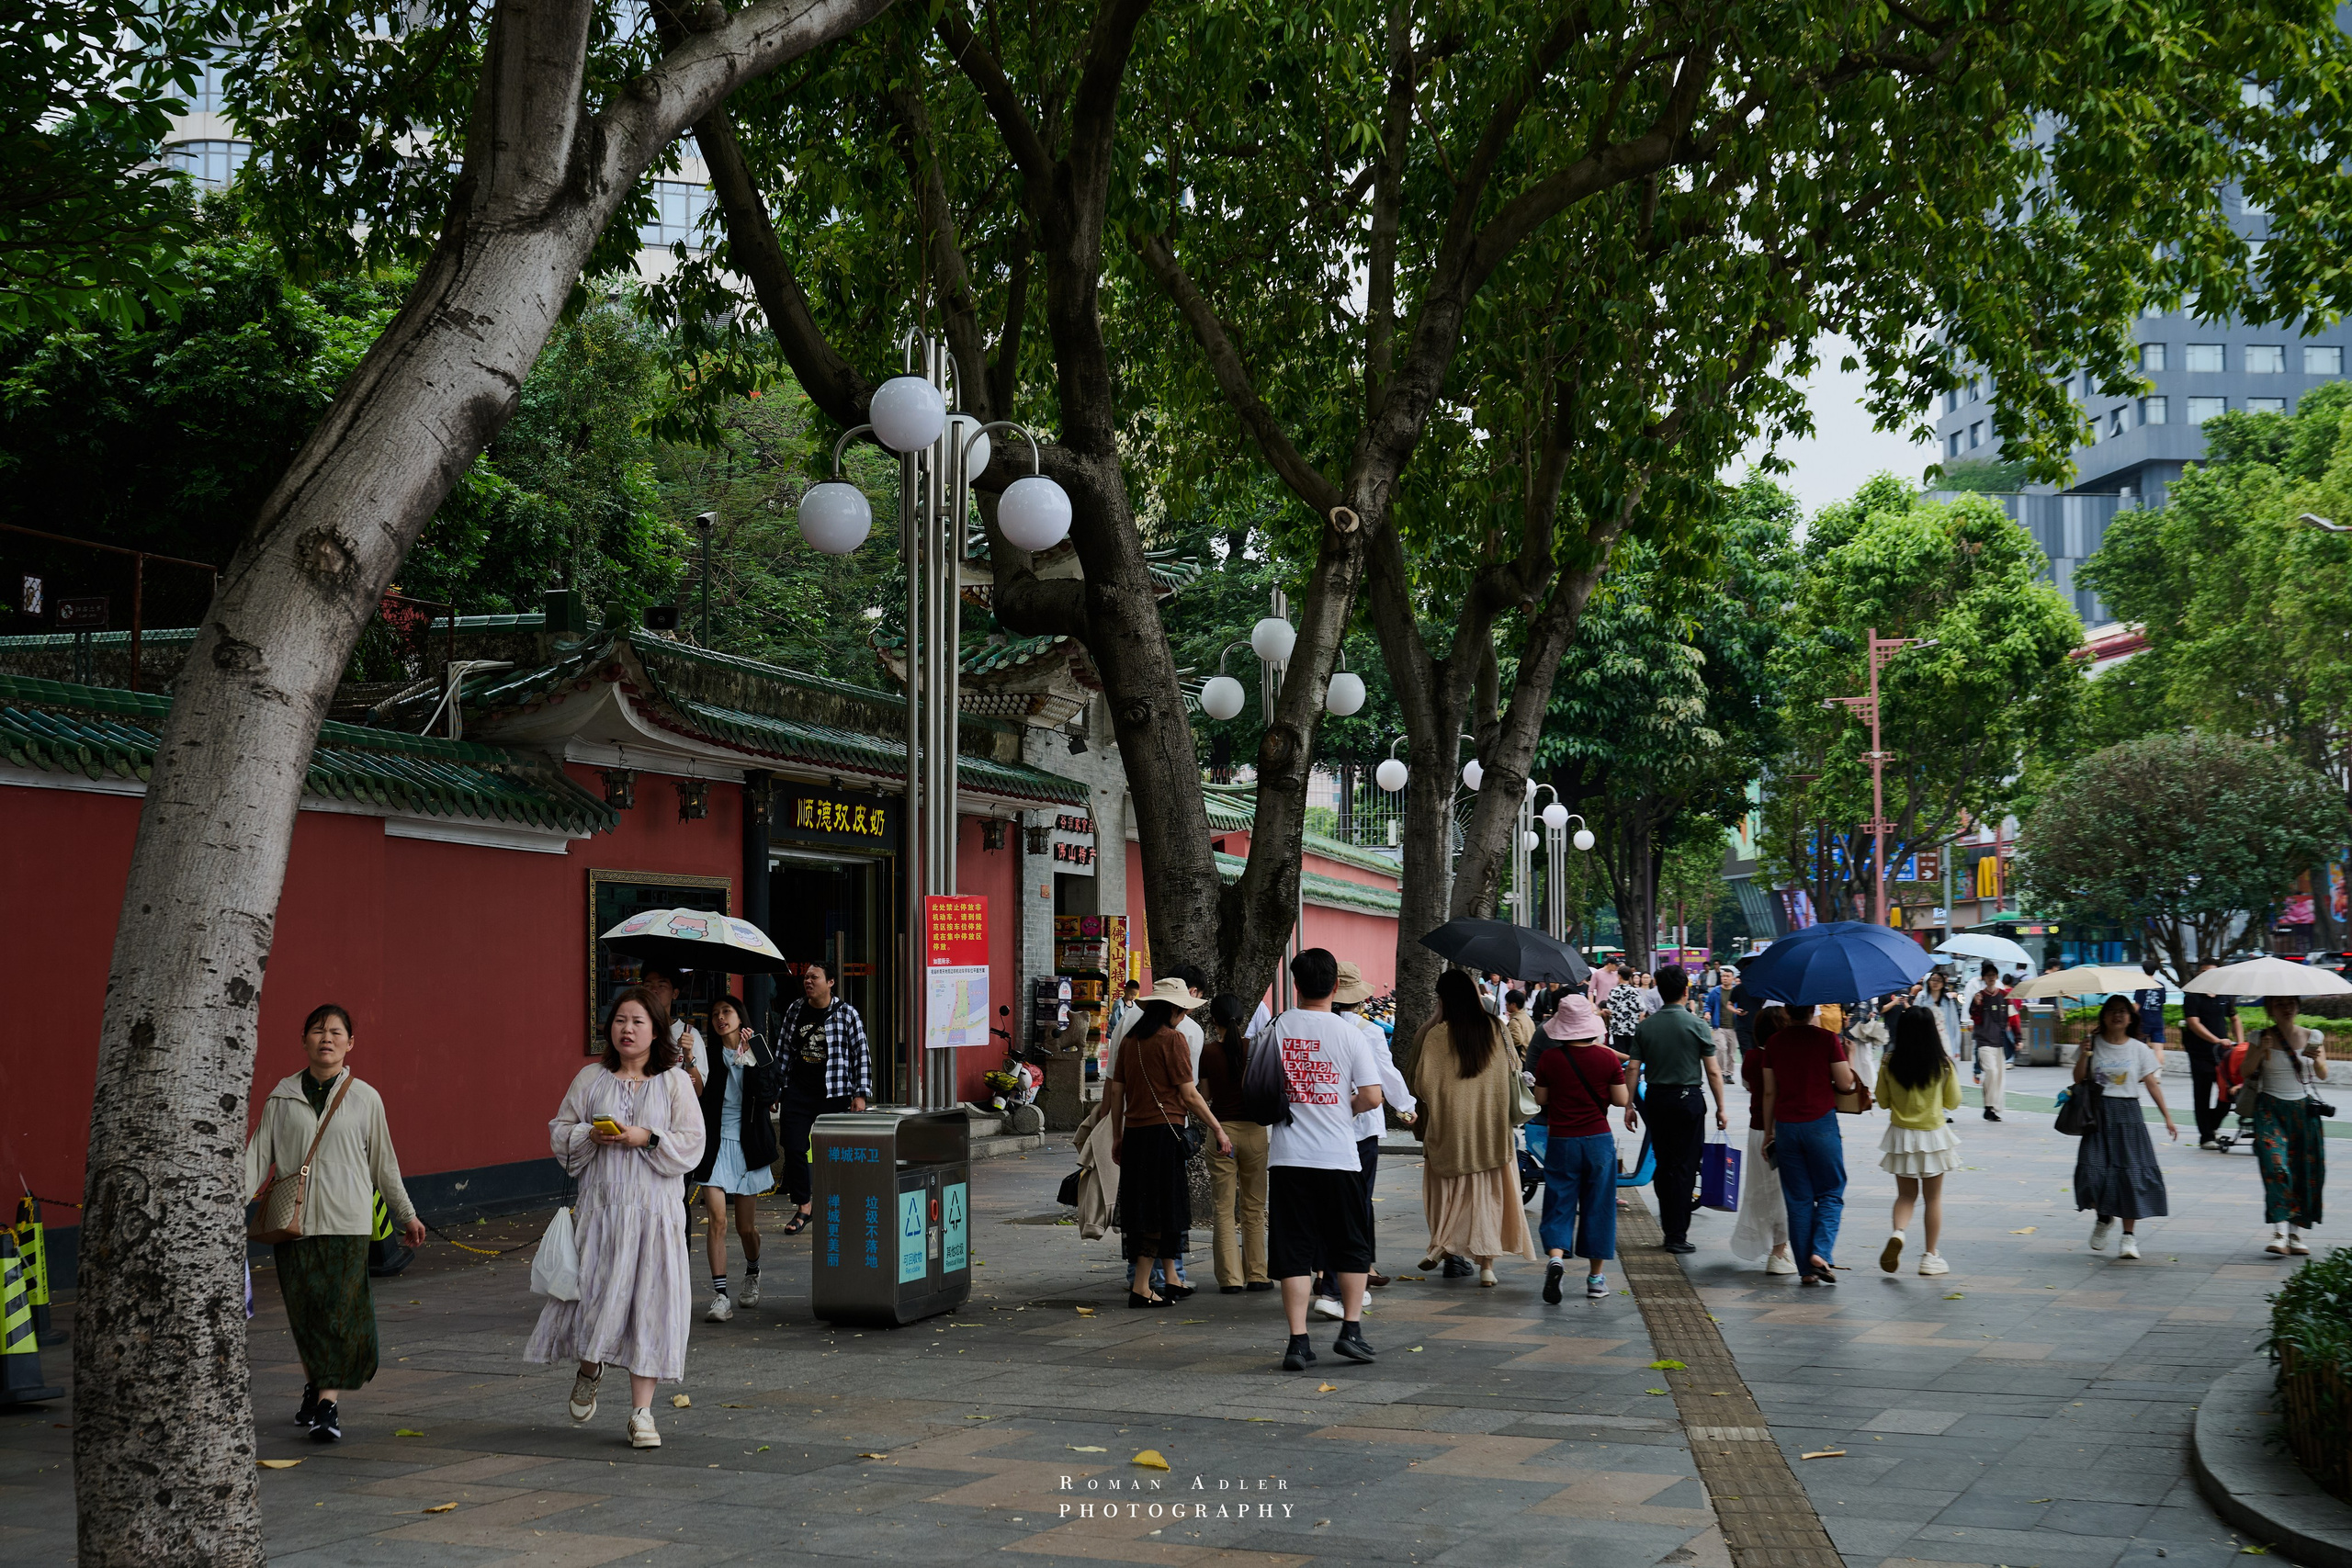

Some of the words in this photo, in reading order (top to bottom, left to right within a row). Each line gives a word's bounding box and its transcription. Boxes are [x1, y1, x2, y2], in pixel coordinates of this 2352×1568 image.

[797, 798, 885, 837] 顺德双皮奶
[1057, 842, 1097, 864] 佛山特产
[932, 903, 982, 911] 此处禁止停放非
[933, 922, 982, 931] 范区按车位停放
[933, 932, 983, 942] 或在集中停放区
[828, 1146, 880, 1163] 禅城环卫
[827, 1194, 841, 1268] 禅城更美丽
[865, 1196, 879, 1269] 垃圾不落地
[903, 1251, 922, 1266] 可回收物
[946, 1243, 964, 1258] 其他垃圾
